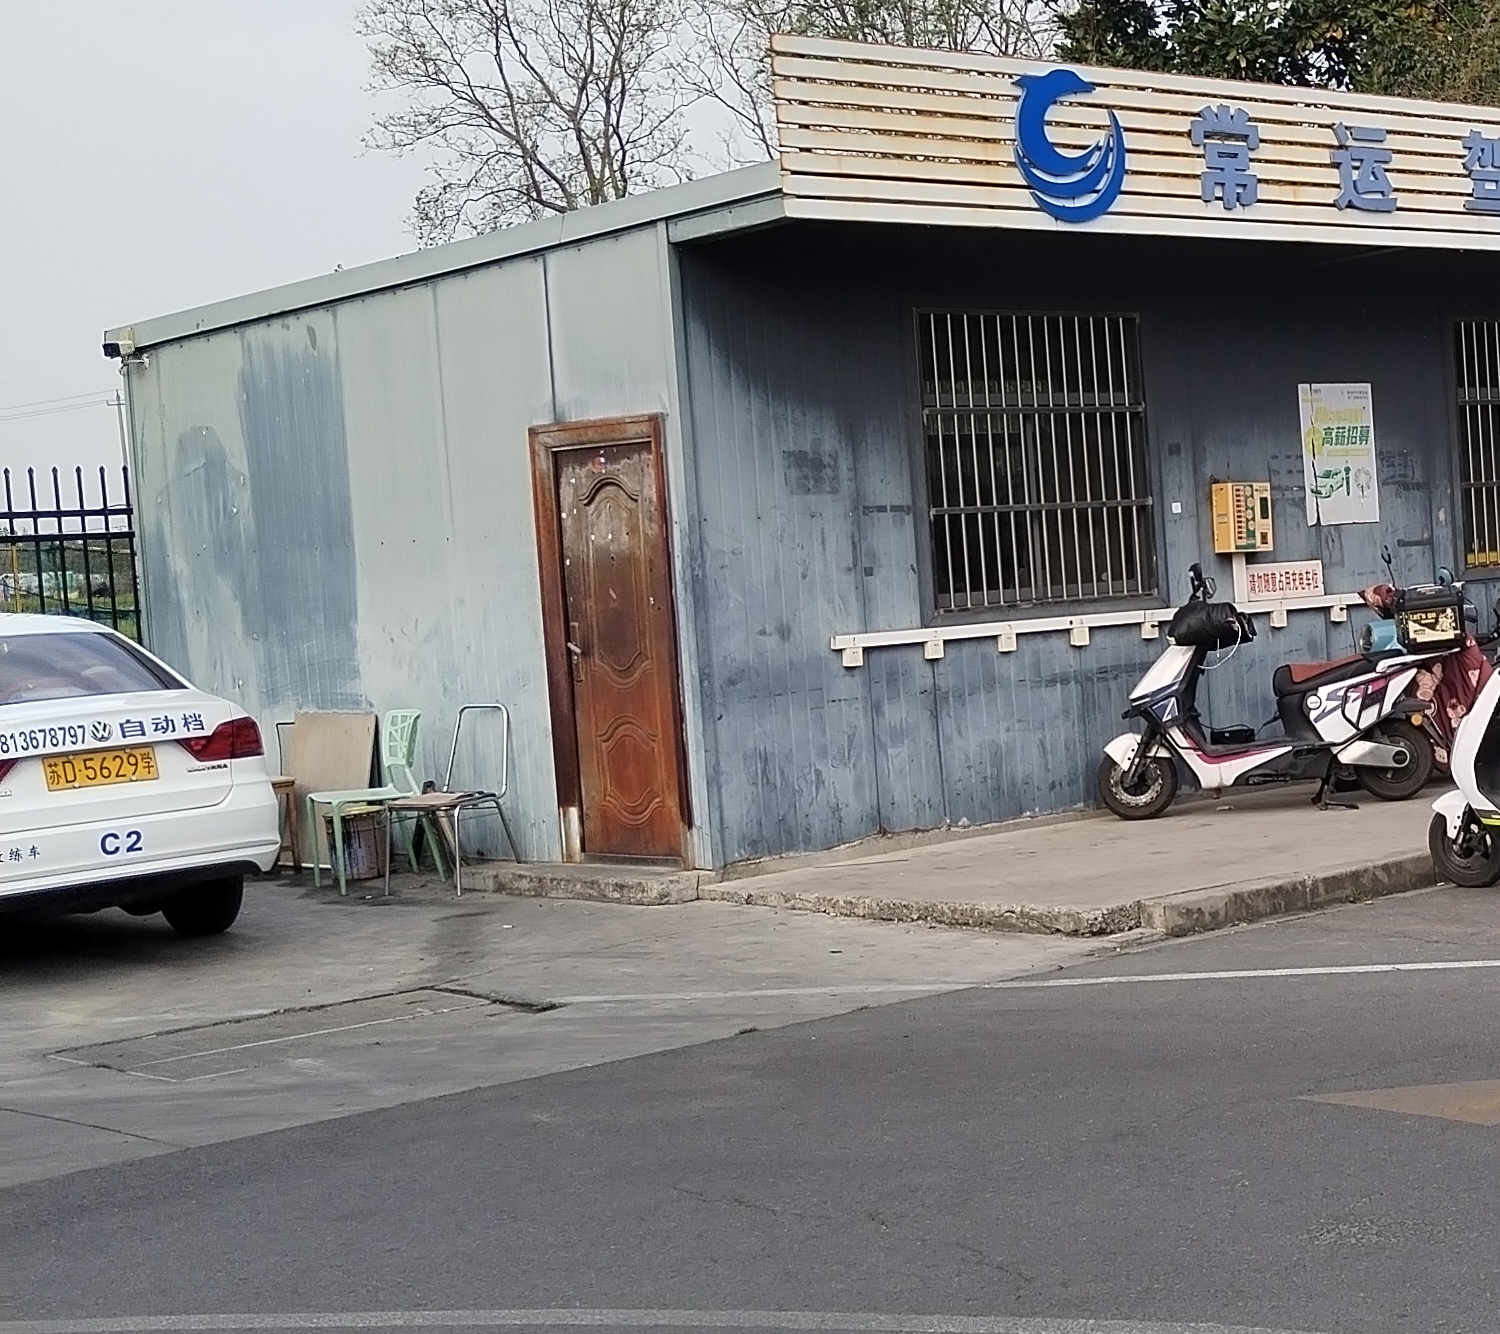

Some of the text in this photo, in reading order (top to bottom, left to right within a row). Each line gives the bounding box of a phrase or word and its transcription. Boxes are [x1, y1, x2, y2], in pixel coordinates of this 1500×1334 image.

[1322, 425, 1371, 447] 高薪招募
[1249, 569, 1320, 594] 请勿随意占用充电车位
[119, 713, 206, 739] 自动档
[100, 830, 143, 856] C2
